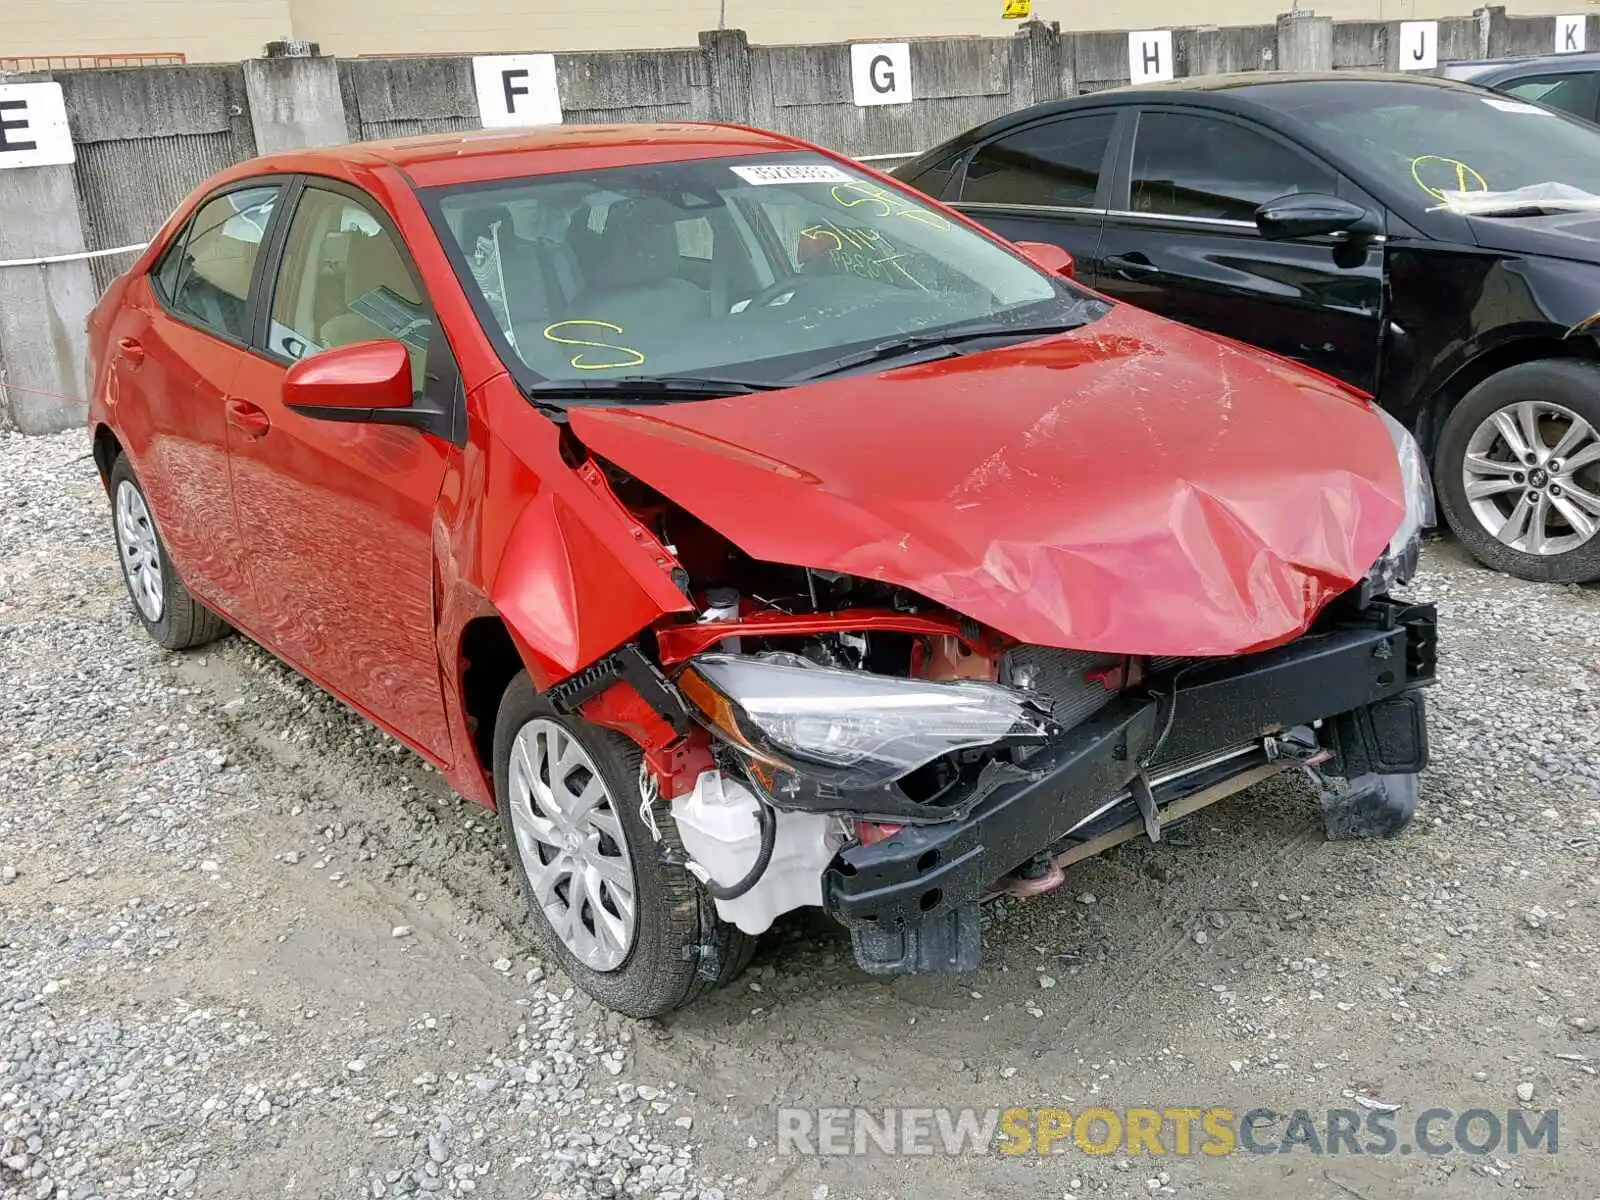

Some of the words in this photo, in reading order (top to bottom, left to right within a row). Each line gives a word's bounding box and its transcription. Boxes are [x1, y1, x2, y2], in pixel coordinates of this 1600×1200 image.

[1413, 31, 1425, 61] J
[1565, 23, 1577, 51] K
[869, 54, 896, 94] G
[1142, 41, 1160, 75] H
[501, 69, 529, 114] F
[0, 99, 38, 153] E
[543, 320, 645, 370] S
